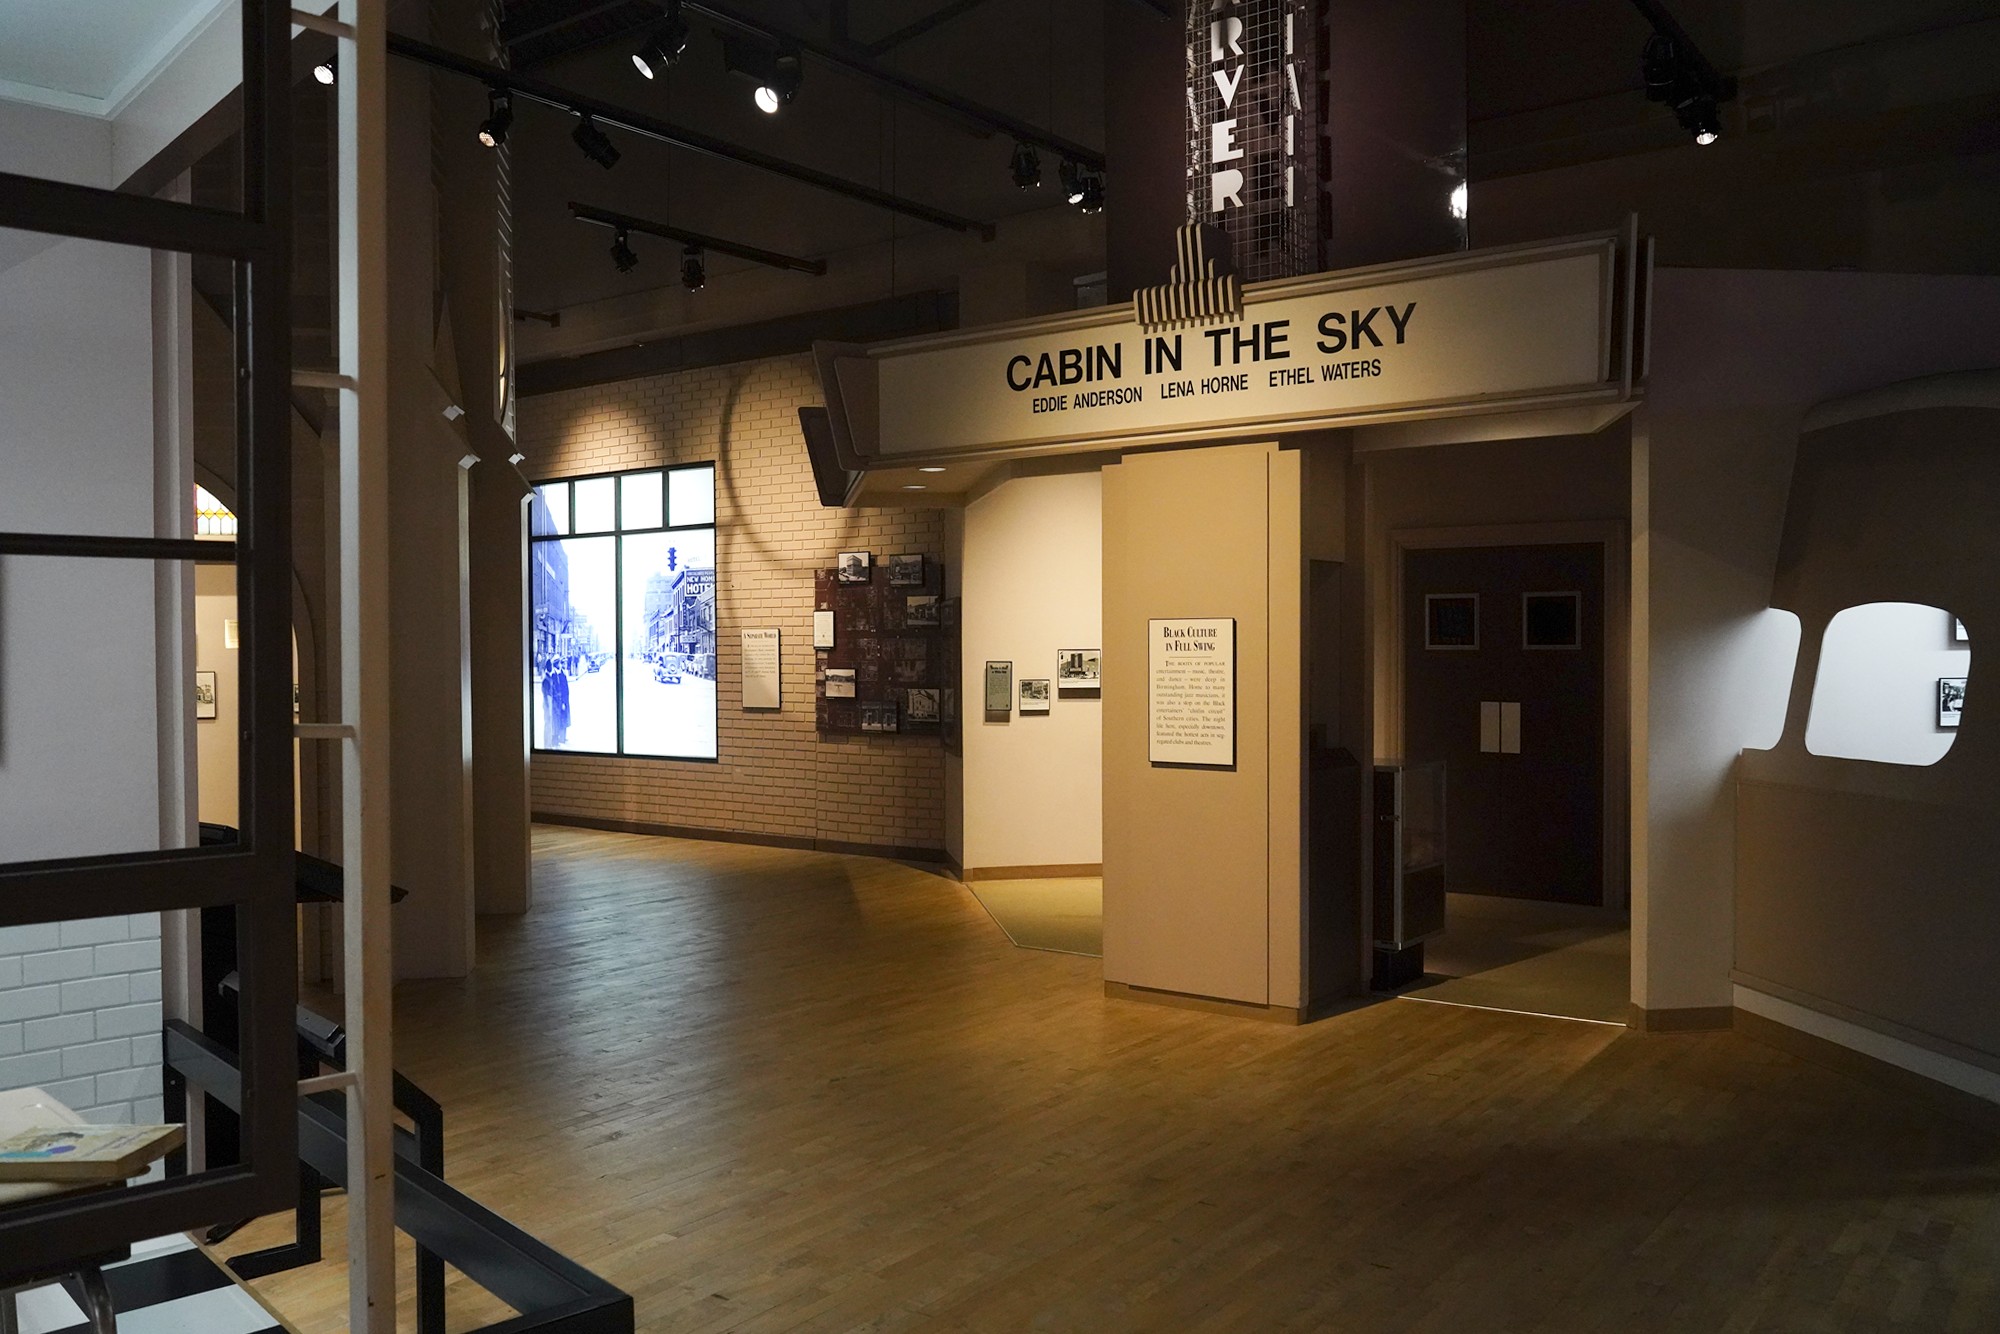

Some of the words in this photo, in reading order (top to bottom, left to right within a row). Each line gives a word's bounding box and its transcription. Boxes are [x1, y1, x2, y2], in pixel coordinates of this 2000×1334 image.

[1211, 0, 1244, 213] RVER
[1006, 342, 1122, 392] CABIN
[1144, 334, 1182, 375] IN
[1204, 319, 1291, 367] THE
[1316, 302, 1417, 354] SKY
[1033, 395, 1068, 414] EDDIE
[1073, 386, 1143, 410] ANDERSON
[1161, 380, 1195, 399] LENA
[1201, 374, 1249, 395] HORNE
[1269, 367, 1315, 388] ETHEL
[1321, 358, 1381, 382] WATERS
